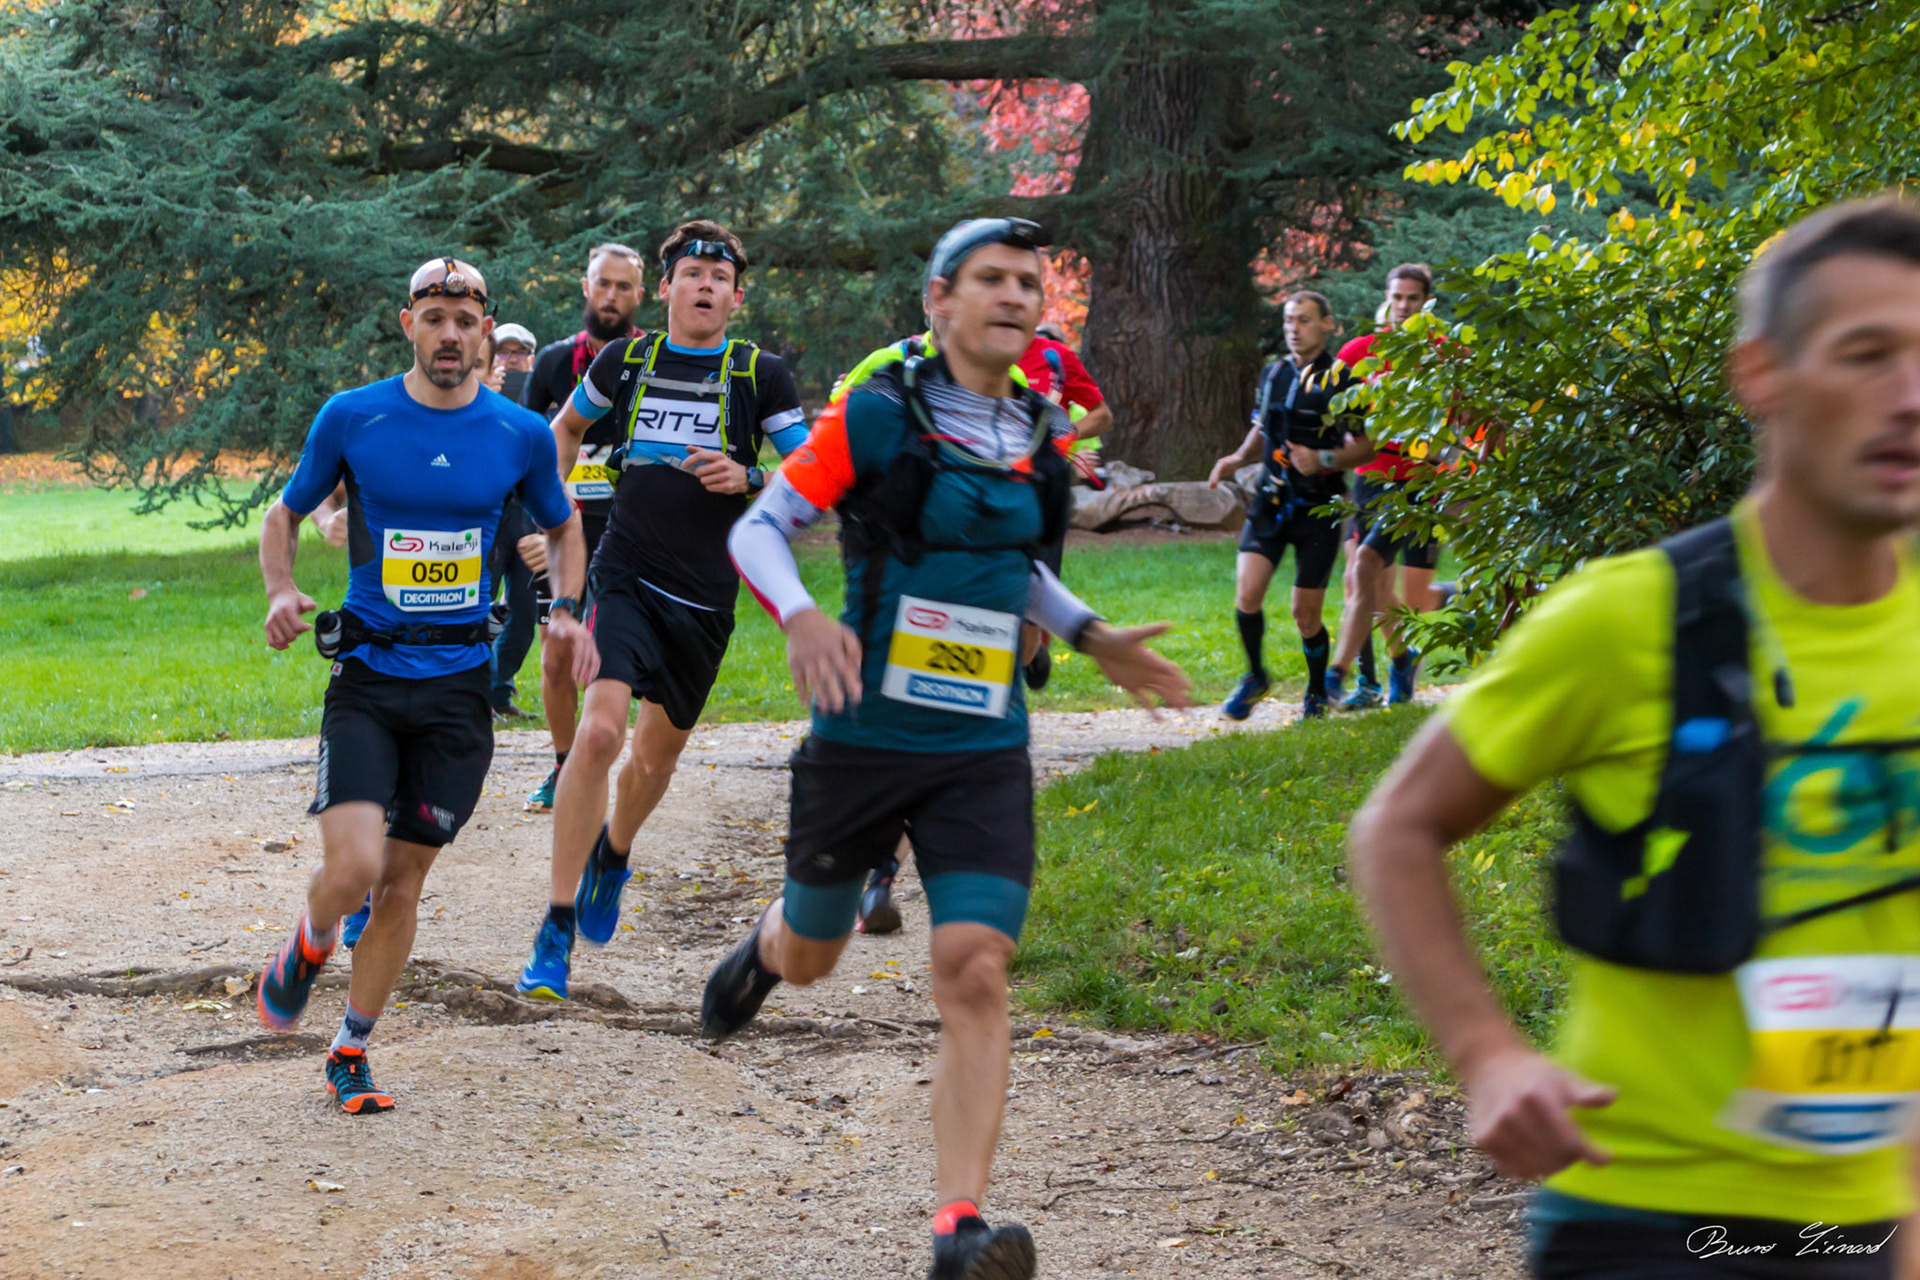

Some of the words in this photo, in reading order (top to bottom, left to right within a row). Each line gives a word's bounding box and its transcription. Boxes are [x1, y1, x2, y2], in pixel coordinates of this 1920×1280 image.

[429, 538, 478, 552] Kalenji
[411, 562, 459, 583] 050
[404, 592, 463, 604] DECATHLON
